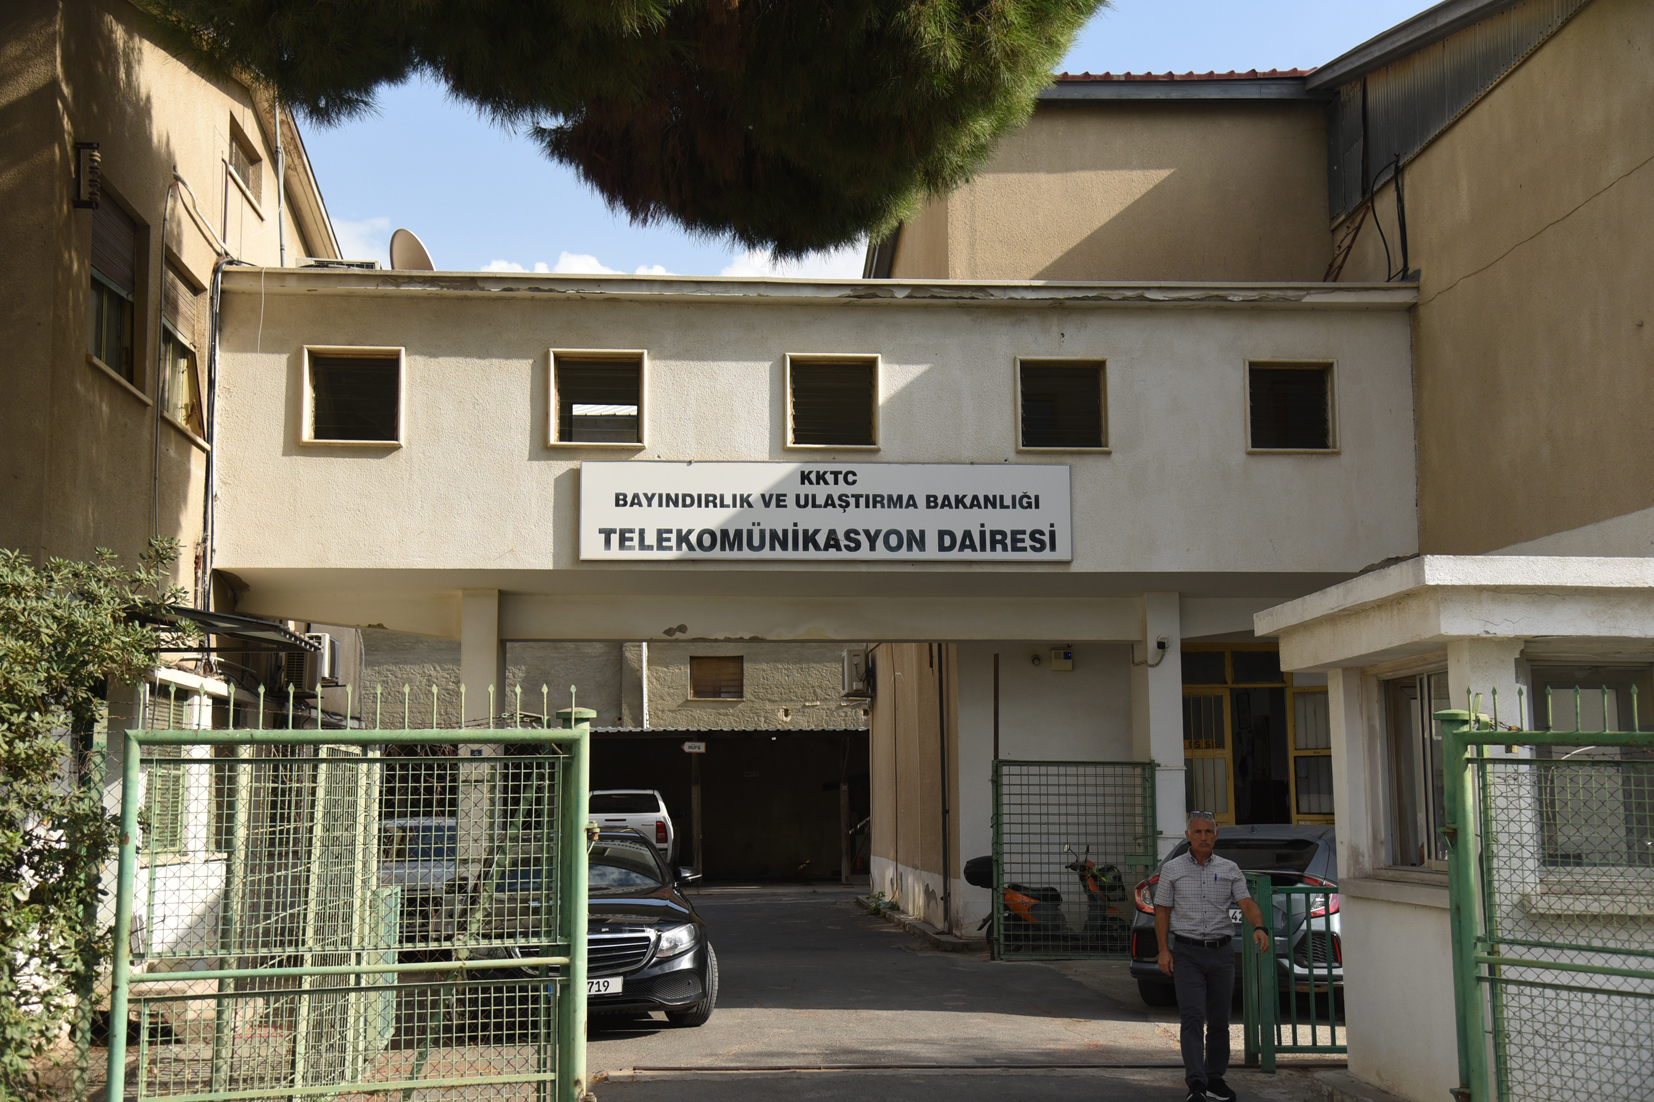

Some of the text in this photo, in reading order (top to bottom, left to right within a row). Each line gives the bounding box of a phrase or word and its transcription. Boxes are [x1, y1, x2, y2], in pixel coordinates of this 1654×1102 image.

[799, 469, 858, 486] KKTC
[614, 491, 1040, 514] BAYINDIRLIK VE ULAŞTIRMA BAKANLIĞI
[598, 522, 1057, 553] TELEKOMÜNİKASYON DAİRESİ
